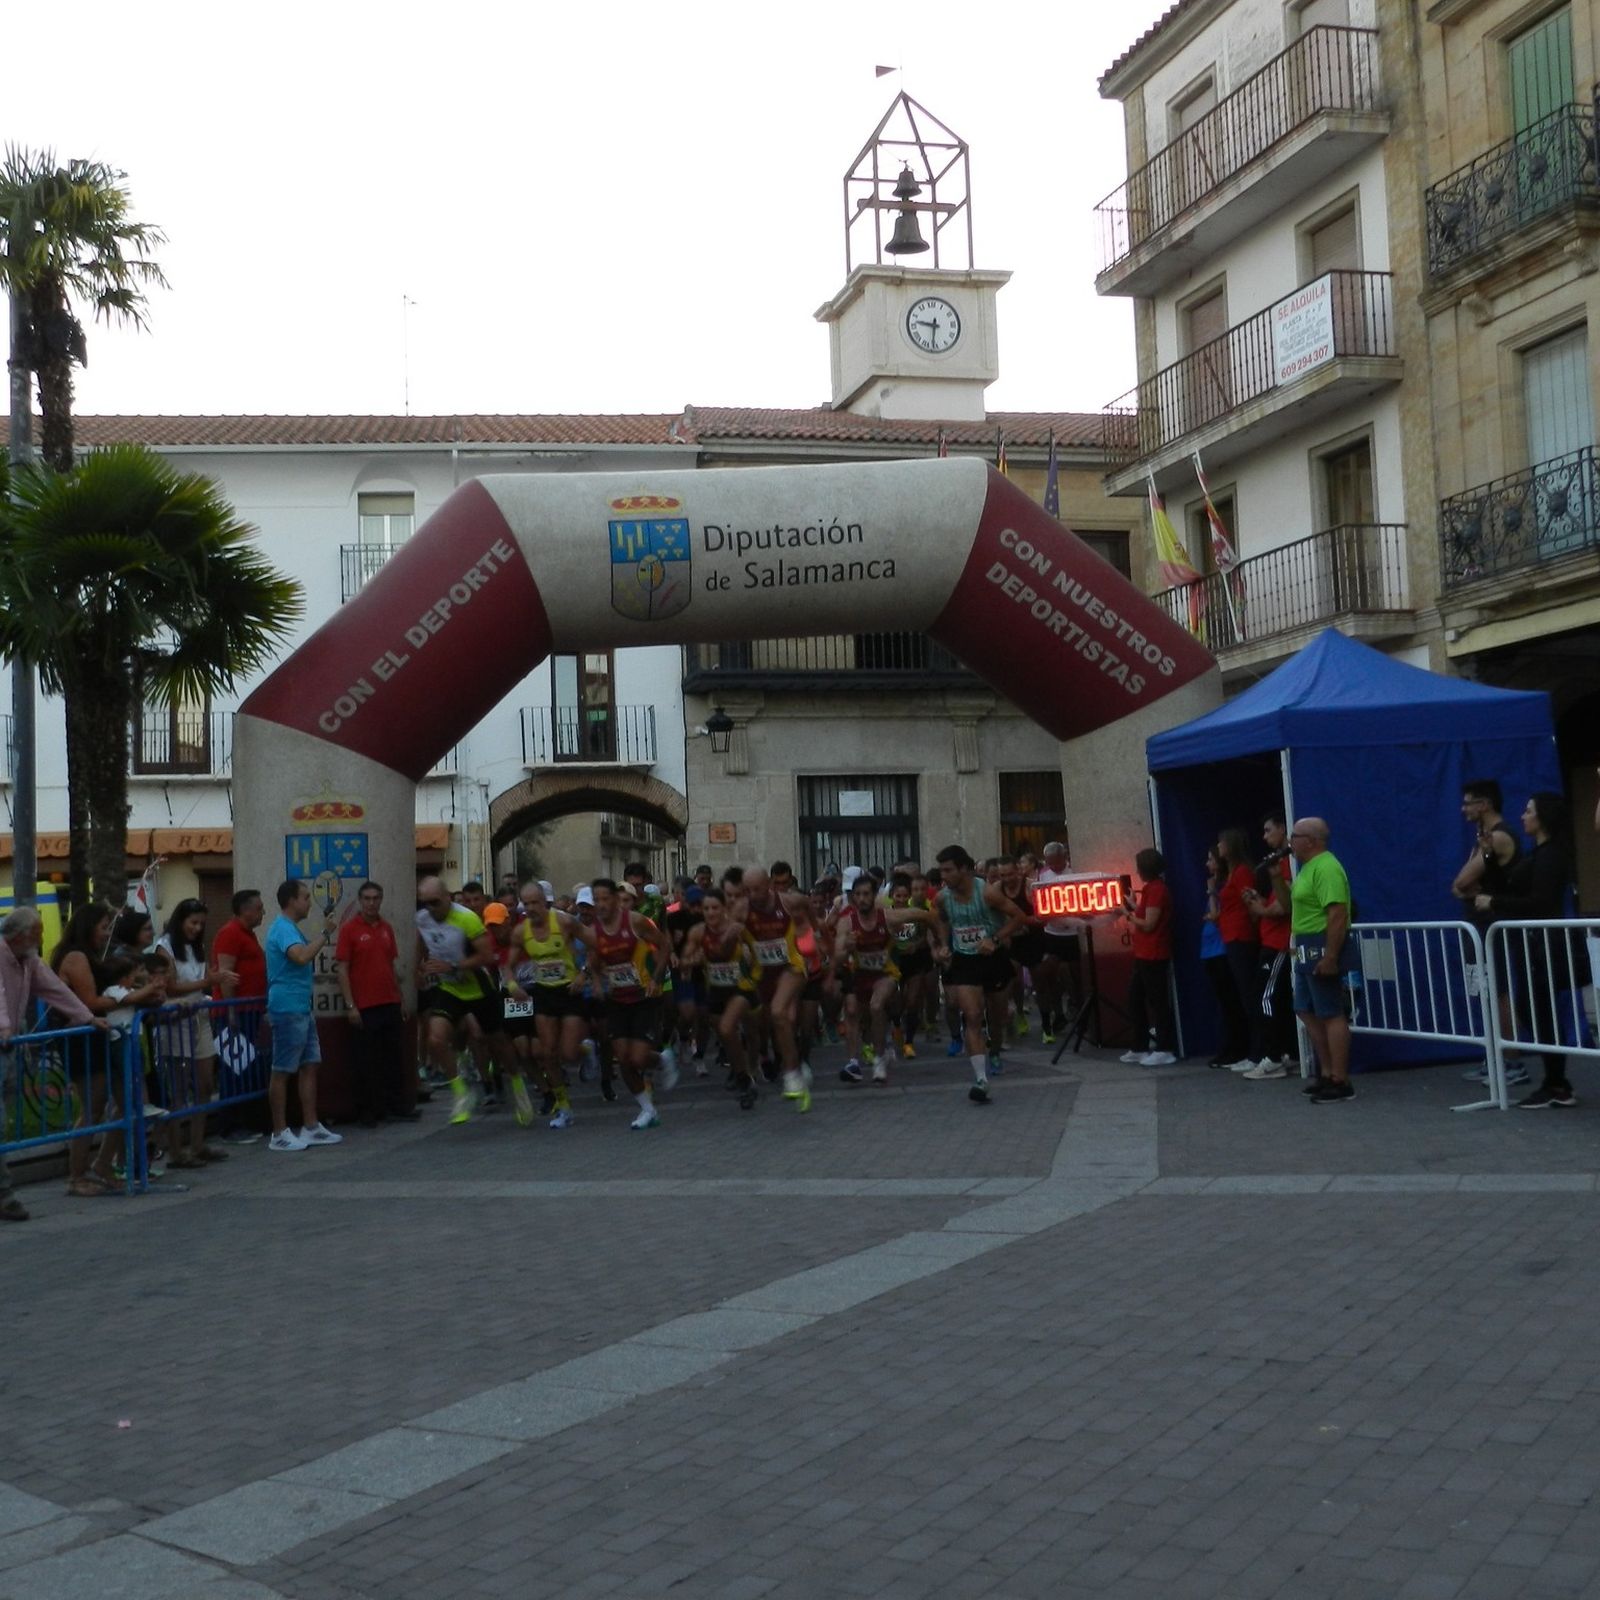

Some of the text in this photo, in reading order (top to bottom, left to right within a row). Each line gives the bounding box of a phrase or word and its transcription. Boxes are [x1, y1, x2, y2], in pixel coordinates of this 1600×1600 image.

[1278, 304, 1289, 320] SE
[1290, 283, 1326, 313] ALQUILA
[1281, 345, 1329, 378] 609 294 307
[703, 517, 864, 557] Diputación
[705, 558, 897, 592] de Salamanca
[1000, 528, 1177, 676] CON NUESTROS
[319, 538, 515, 733] CON EL DEPORTE
[985, 561, 1147, 695] DEPORTISTAS
[509, 1003, 529, 1013] 358
